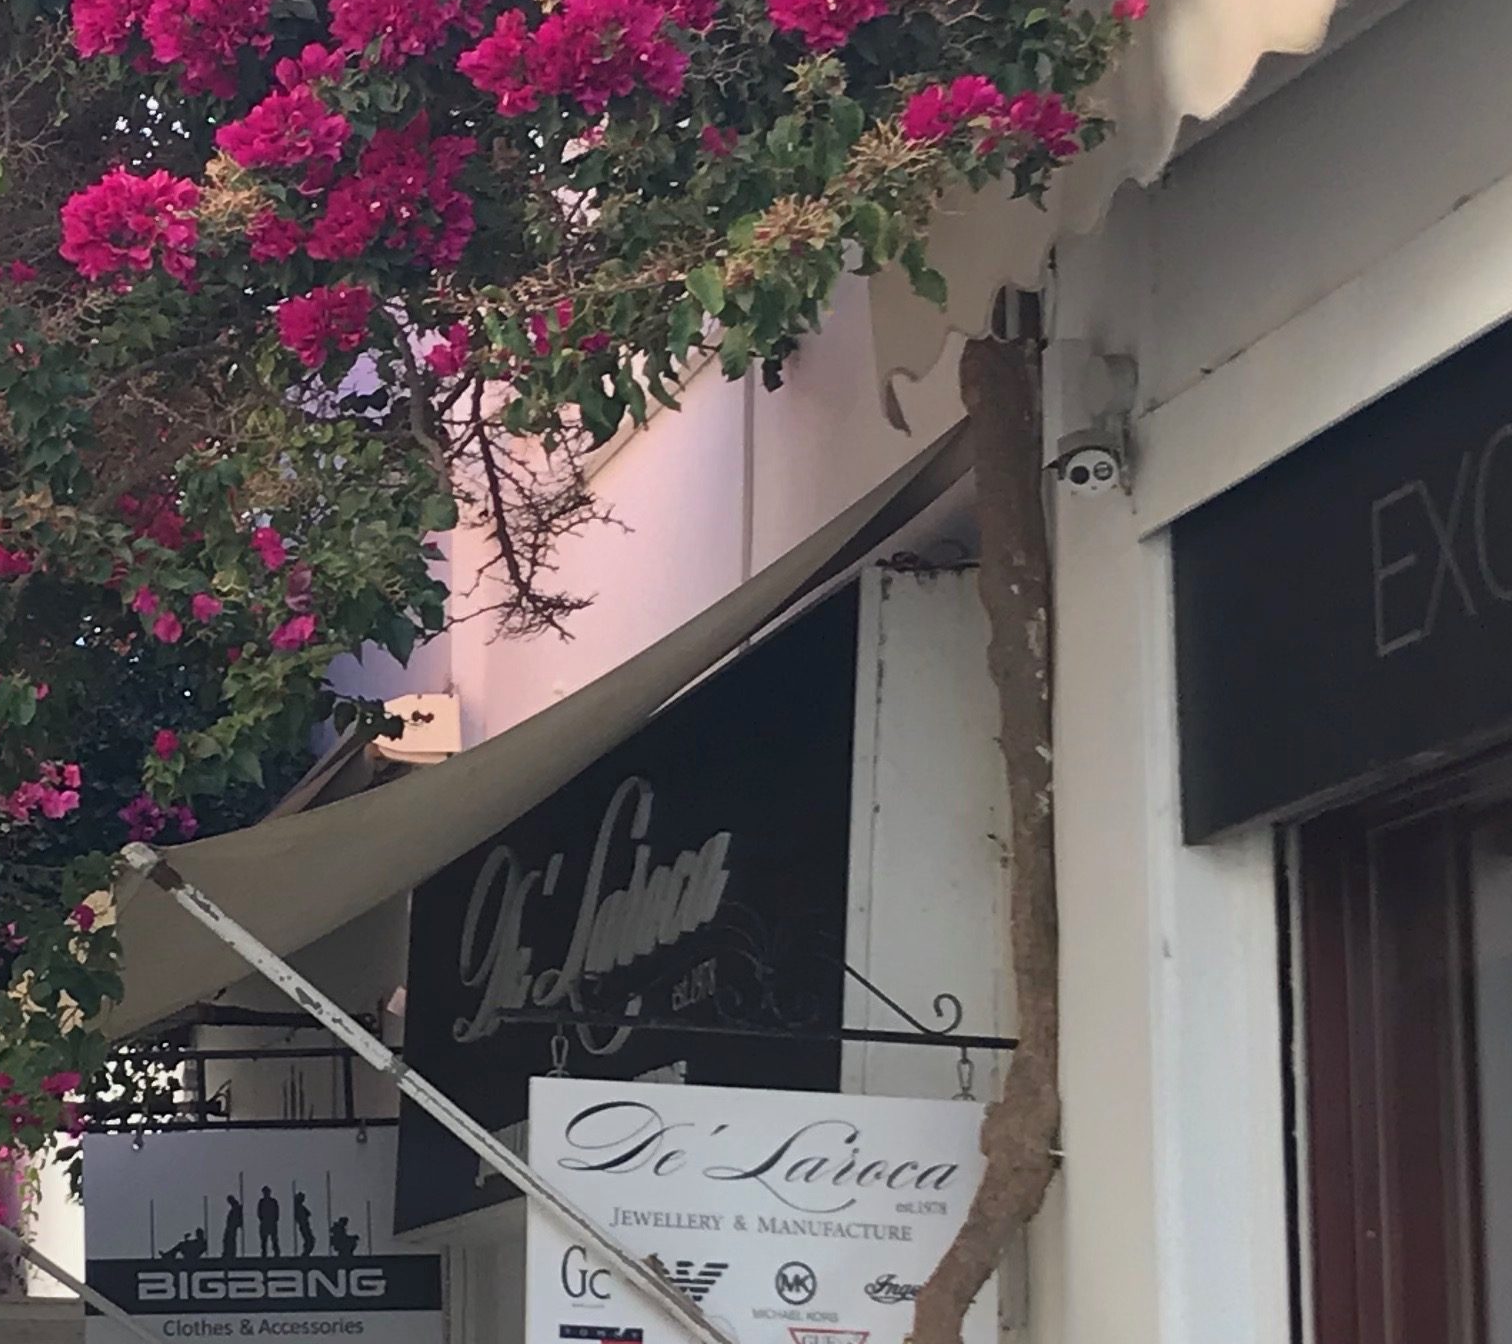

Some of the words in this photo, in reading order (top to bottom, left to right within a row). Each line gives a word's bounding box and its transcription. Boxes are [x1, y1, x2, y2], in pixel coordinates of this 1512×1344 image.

[609, 1206, 724, 1232] JEWELLERY
[733, 1214, 748, 1231] &
[757, 1216, 913, 1242] MANUFACTURE
[163, 1318, 234, 1337] Clothes
[239, 1318, 255, 1336] &
[257, 1318, 364, 1336] Accessories
